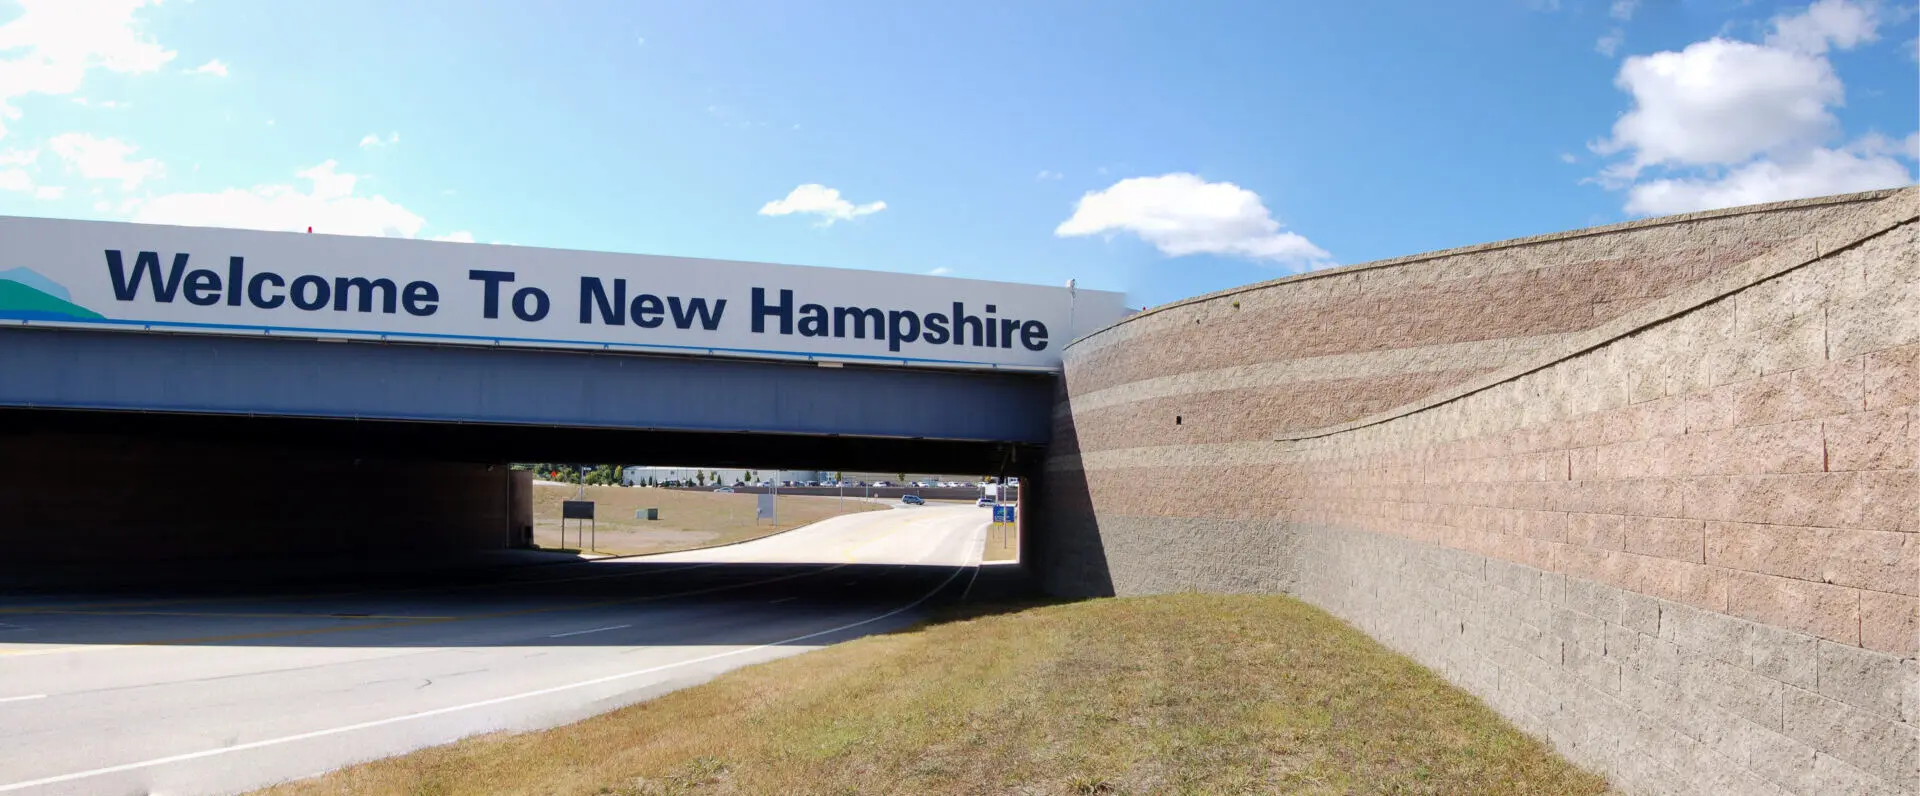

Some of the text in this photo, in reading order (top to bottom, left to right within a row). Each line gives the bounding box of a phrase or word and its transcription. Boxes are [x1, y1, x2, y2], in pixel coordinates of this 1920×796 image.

[105, 249, 1049, 352] Welcome To New Hampshire
